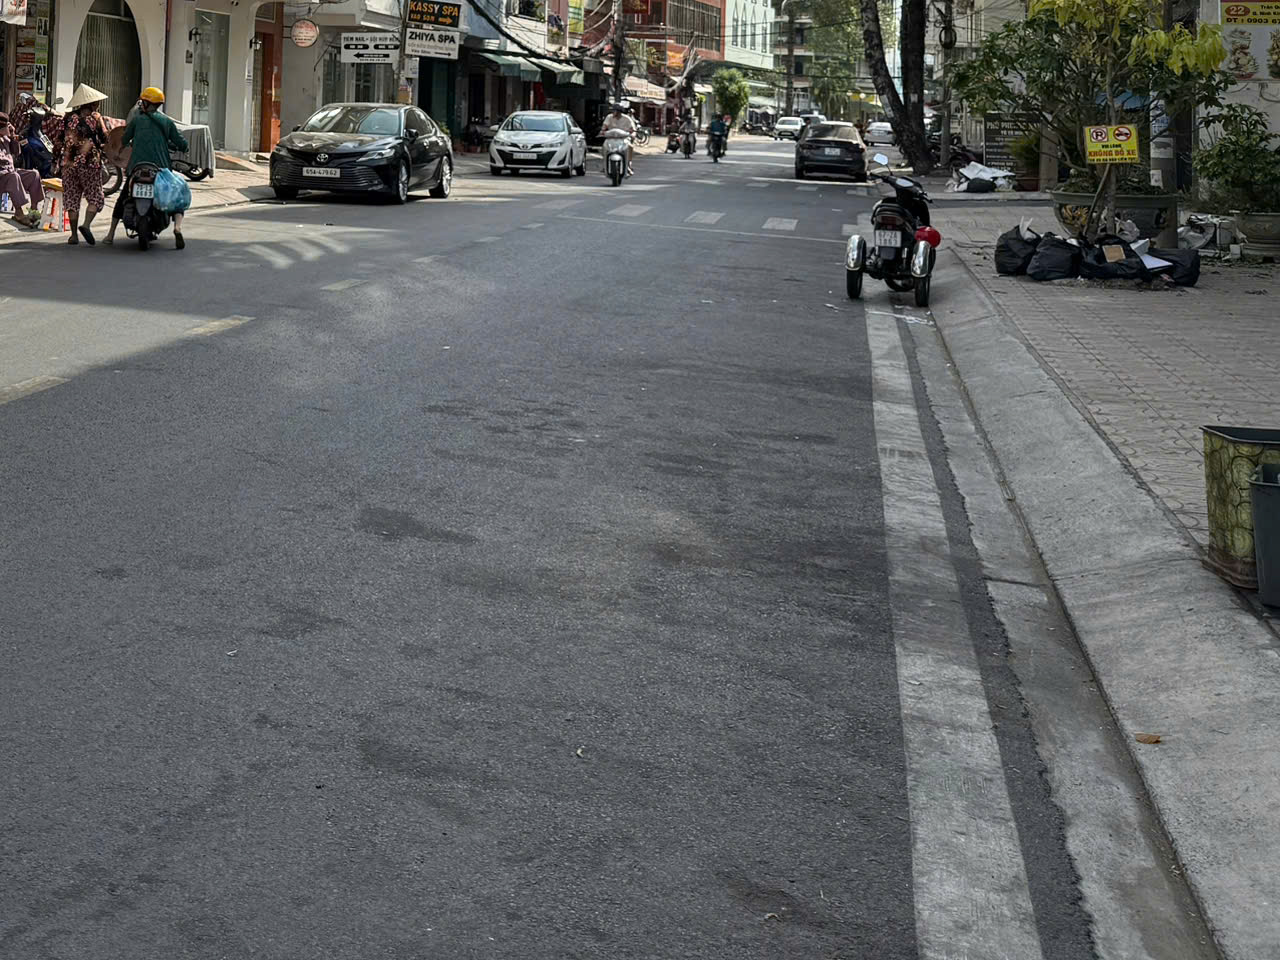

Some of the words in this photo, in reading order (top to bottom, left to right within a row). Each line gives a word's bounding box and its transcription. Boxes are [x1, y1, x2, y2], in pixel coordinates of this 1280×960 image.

[410, 1, 440, 14] KASSY
[441, 5, 459, 17] SPA
[1230, 6, 1245, 15] 22
[408, 31, 436, 42] ZHIYA
[437, 34, 456, 44] SPA
